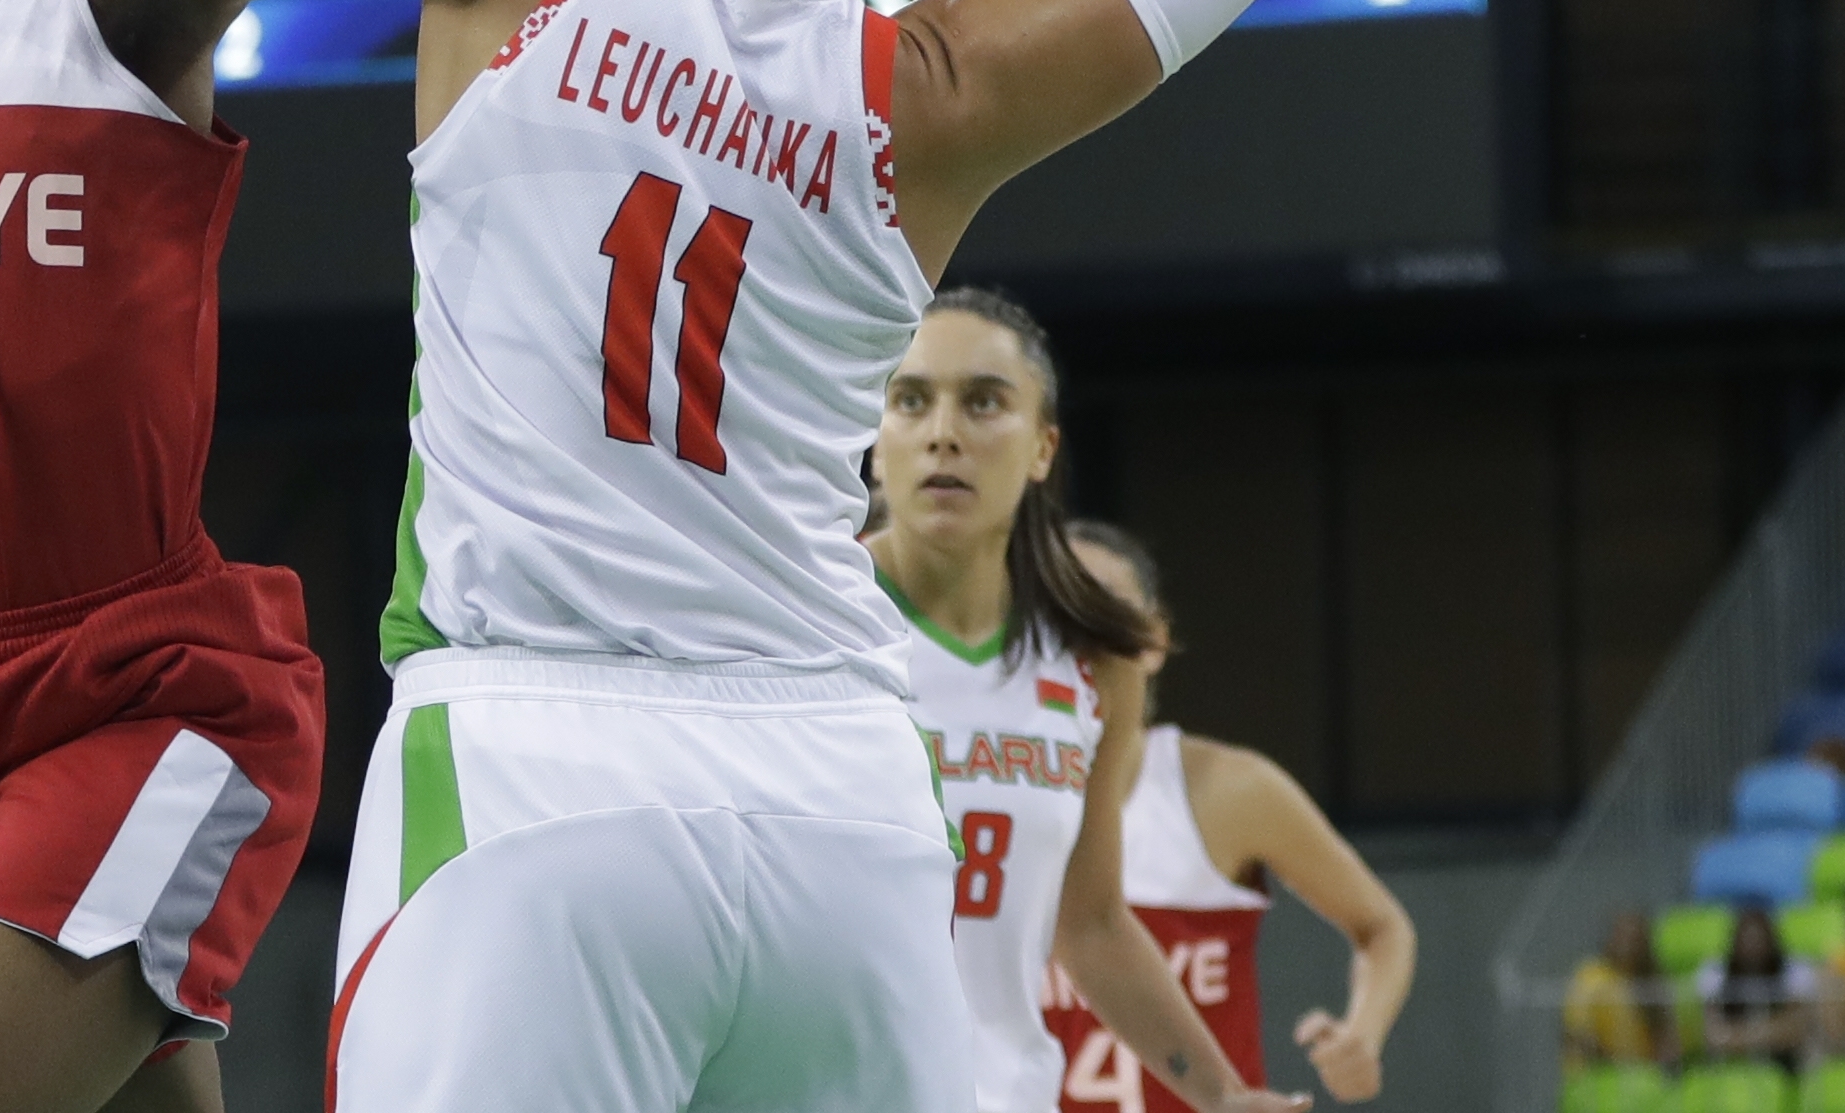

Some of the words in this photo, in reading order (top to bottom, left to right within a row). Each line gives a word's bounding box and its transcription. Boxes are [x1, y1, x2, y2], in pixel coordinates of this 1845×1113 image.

[598, 170, 754, 476] 11
[926, 728, 1091, 796] LARUS
[954, 808, 1014, 920] 8
